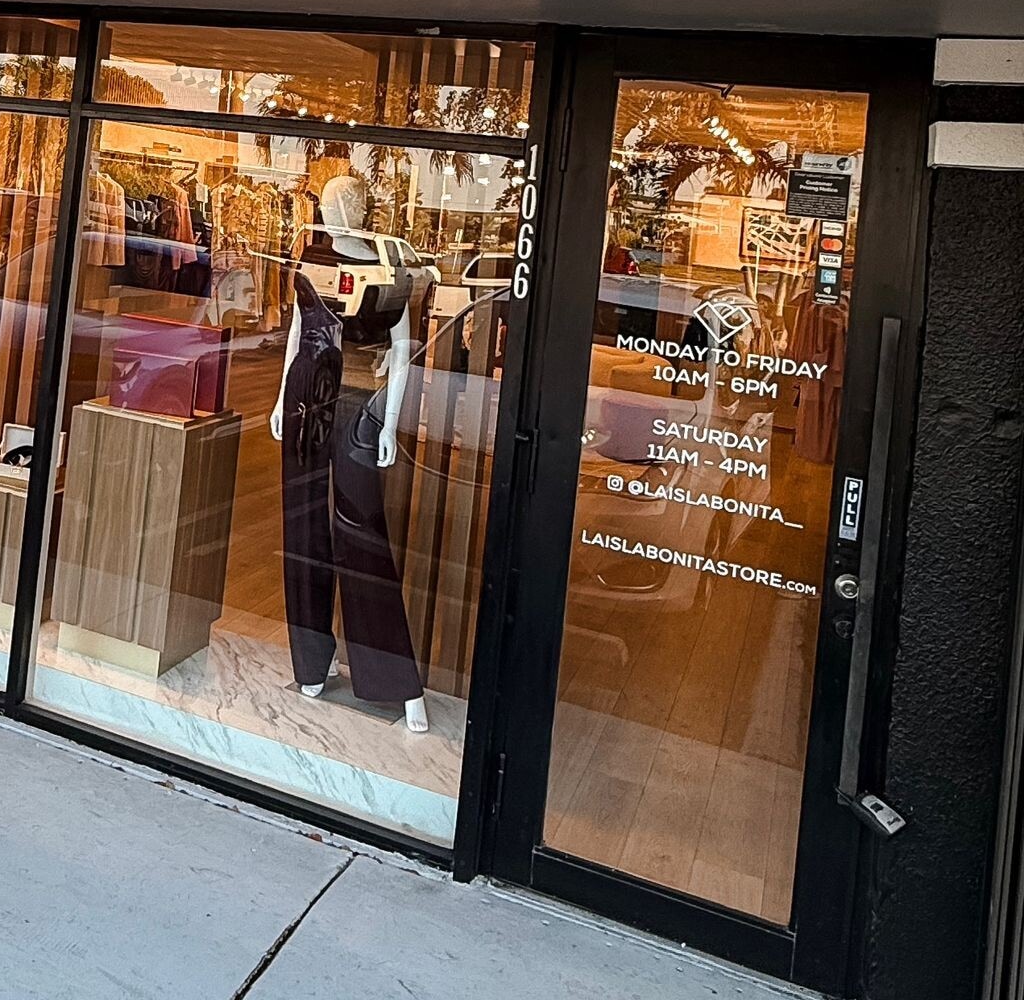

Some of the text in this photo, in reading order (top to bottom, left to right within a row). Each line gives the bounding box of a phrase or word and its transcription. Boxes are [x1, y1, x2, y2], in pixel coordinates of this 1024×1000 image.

[513, 143, 539, 299] 1066
[616, 334, 828, 380] MONDAY TO FRIDAY
[652, 365, 710, 388] 10AM
[730, 377, 778, 399] 6PM
[652, 419, 768, 454] SATURDAY
[646, 443, 699, 467] 11AM
[718, 457, 767, 481] 4PM
[845, 480, 859, 527] PULL
[581, 529, 816, 595] LAISLABONITASTORE.COM
